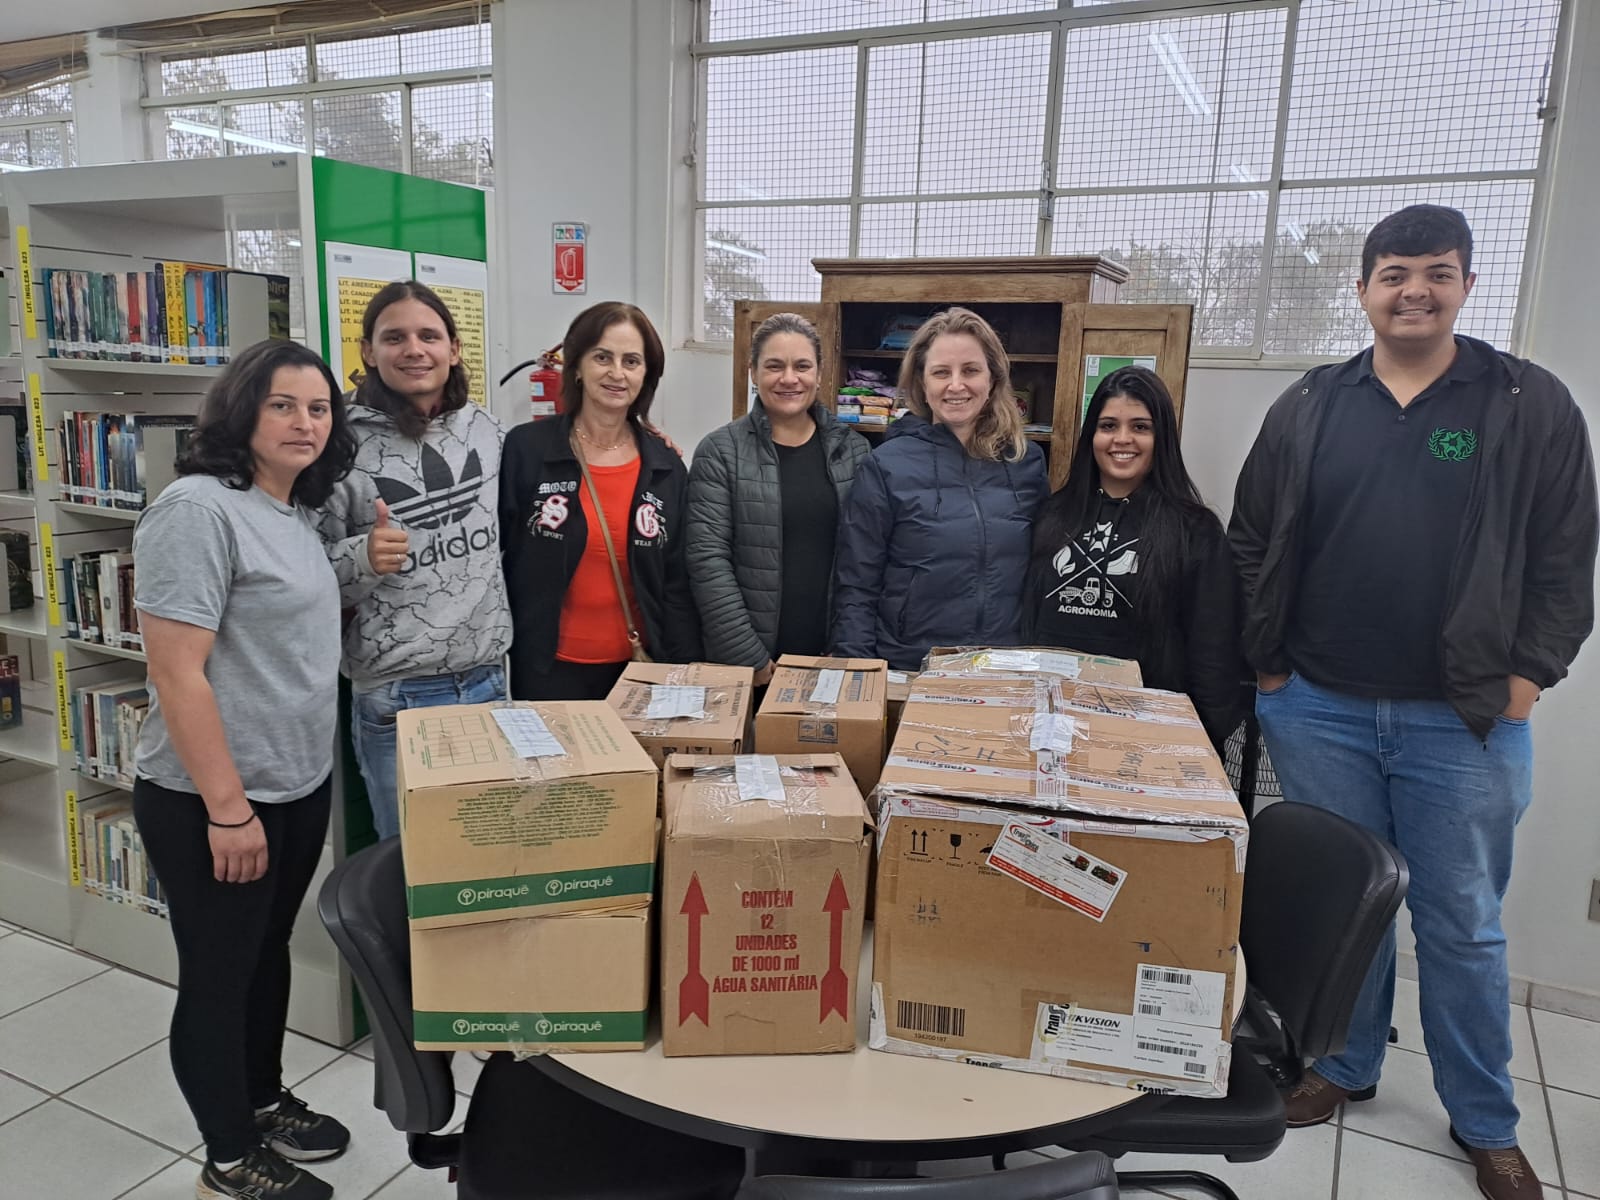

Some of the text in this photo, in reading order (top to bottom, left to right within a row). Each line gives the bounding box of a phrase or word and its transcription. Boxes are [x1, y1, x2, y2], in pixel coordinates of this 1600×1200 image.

[23, 268, 32, 299] INGLESA
[35, 414, 44, 444] INGLESA
[396, 519, 498, 575] adidas
[1057, 604, 1119, 619] AGRONOMIA
[563, 874, 614, 893] piraquê
[476, 884, 530, 902] piraquê
[741, 887, 794, 908] CONTÉM
[760, 914, 774, 930] 12
[735, 934, 798, 951] UNIDADES
[732, 954, 800, 972] DE 1000 ml
[712, 974, 818, 993] ÁGUA SANITÁRIA
[470, 1021, 521, 1034] piraquê
[553, 1021, 603, 1034] piraquê
